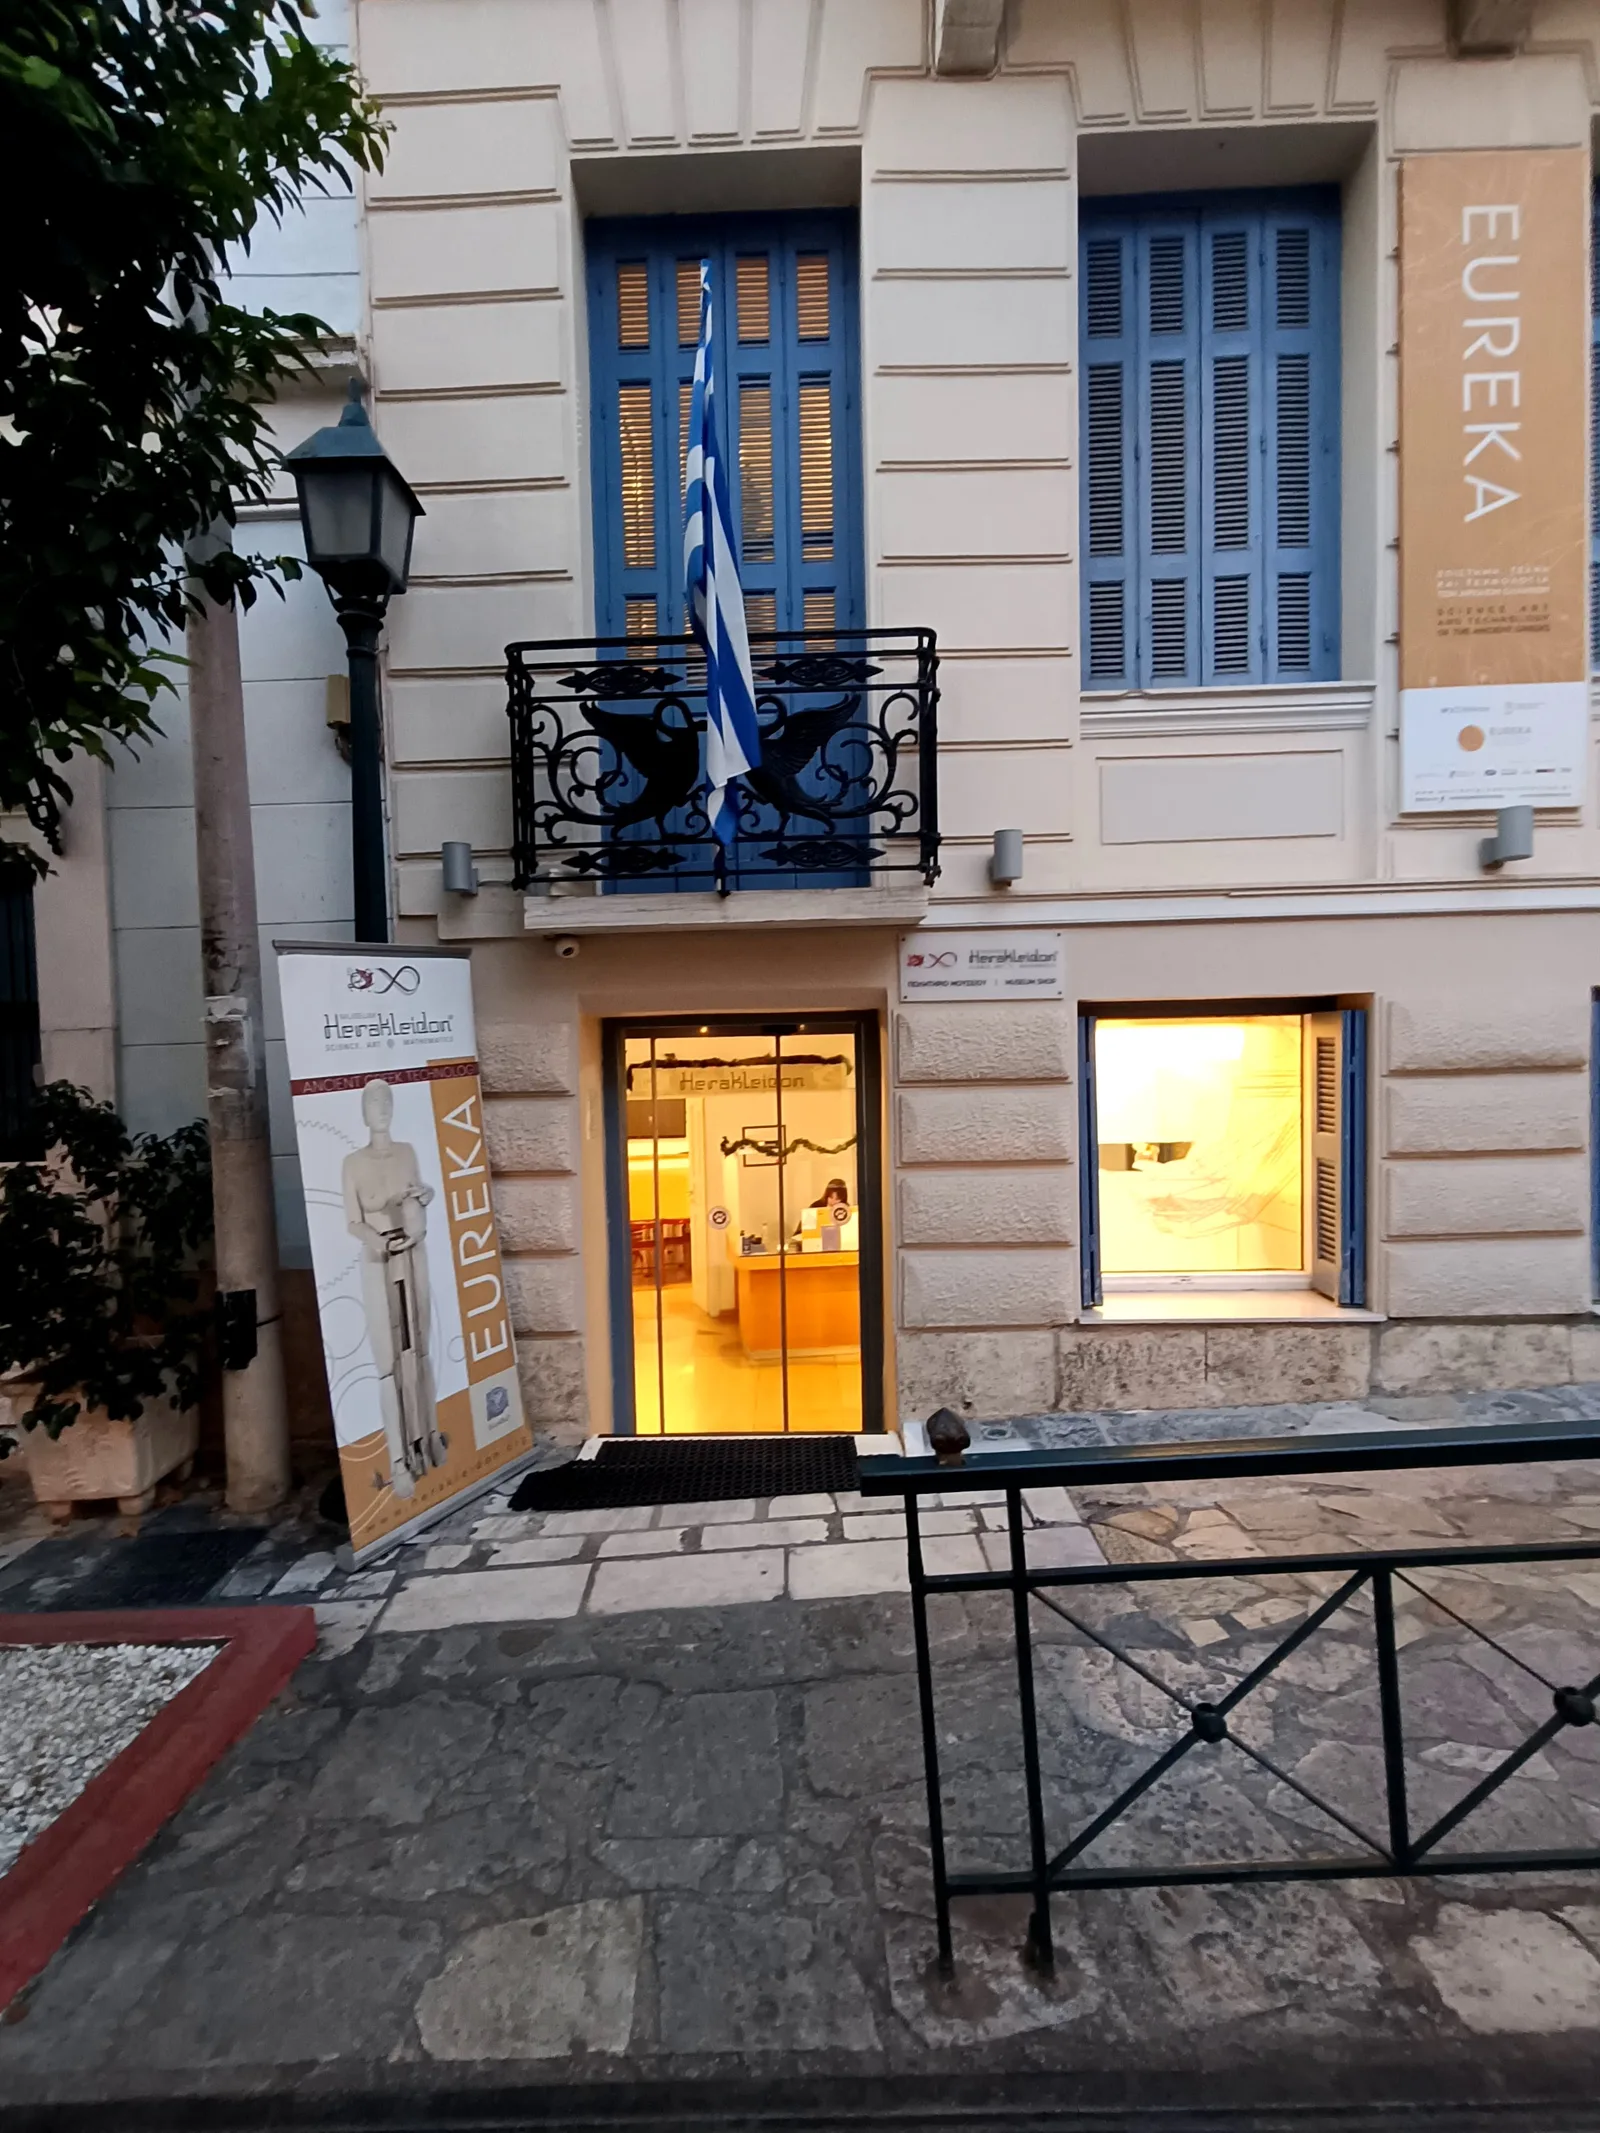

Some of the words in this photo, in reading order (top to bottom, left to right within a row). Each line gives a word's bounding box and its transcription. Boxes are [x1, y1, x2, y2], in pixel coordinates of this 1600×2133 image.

[1462, 204, 1521, 523] EUREKA
[302, 1076, 361, 1093] ANCIENT
[442, 1094, 508, 1362] EUREKA
